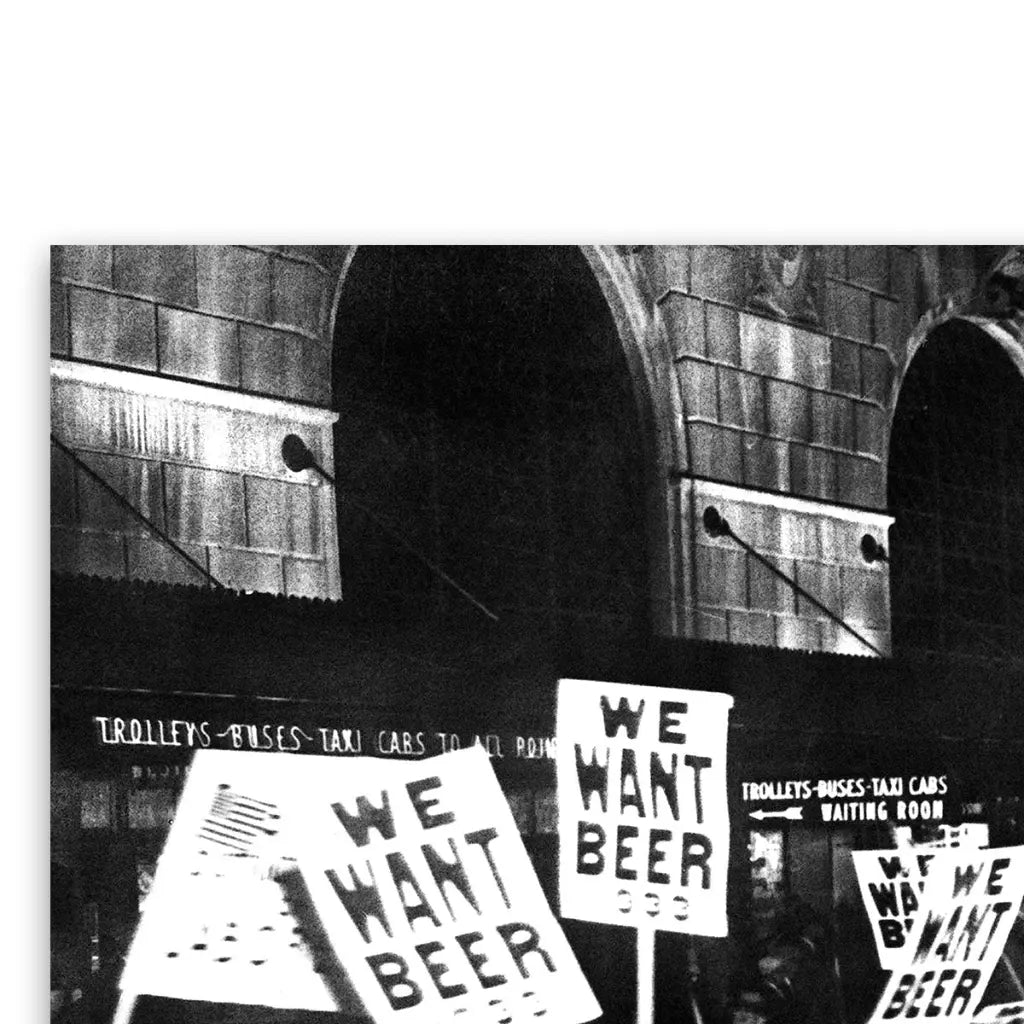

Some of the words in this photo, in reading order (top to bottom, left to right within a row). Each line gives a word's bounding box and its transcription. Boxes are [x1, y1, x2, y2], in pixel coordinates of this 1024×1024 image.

[378, 730, 425, 755] CABS
[600, 695, 688, 745] WE
[574, 742, 712, 824] WANT
[908, 774, 948, 796] CABS
[330, 776, 456, 847] WE
[821, 802, 887, 821] WAITING
[897, 800, 944, 820] ROOM
[576, 820, 713, 890] BEER
[952, 858, 1011, 899] WE
[324, 827, 511, 944] WANT
[364, 922, 557, 1011] BEER
[882, 969, 981, 1019] BEER
